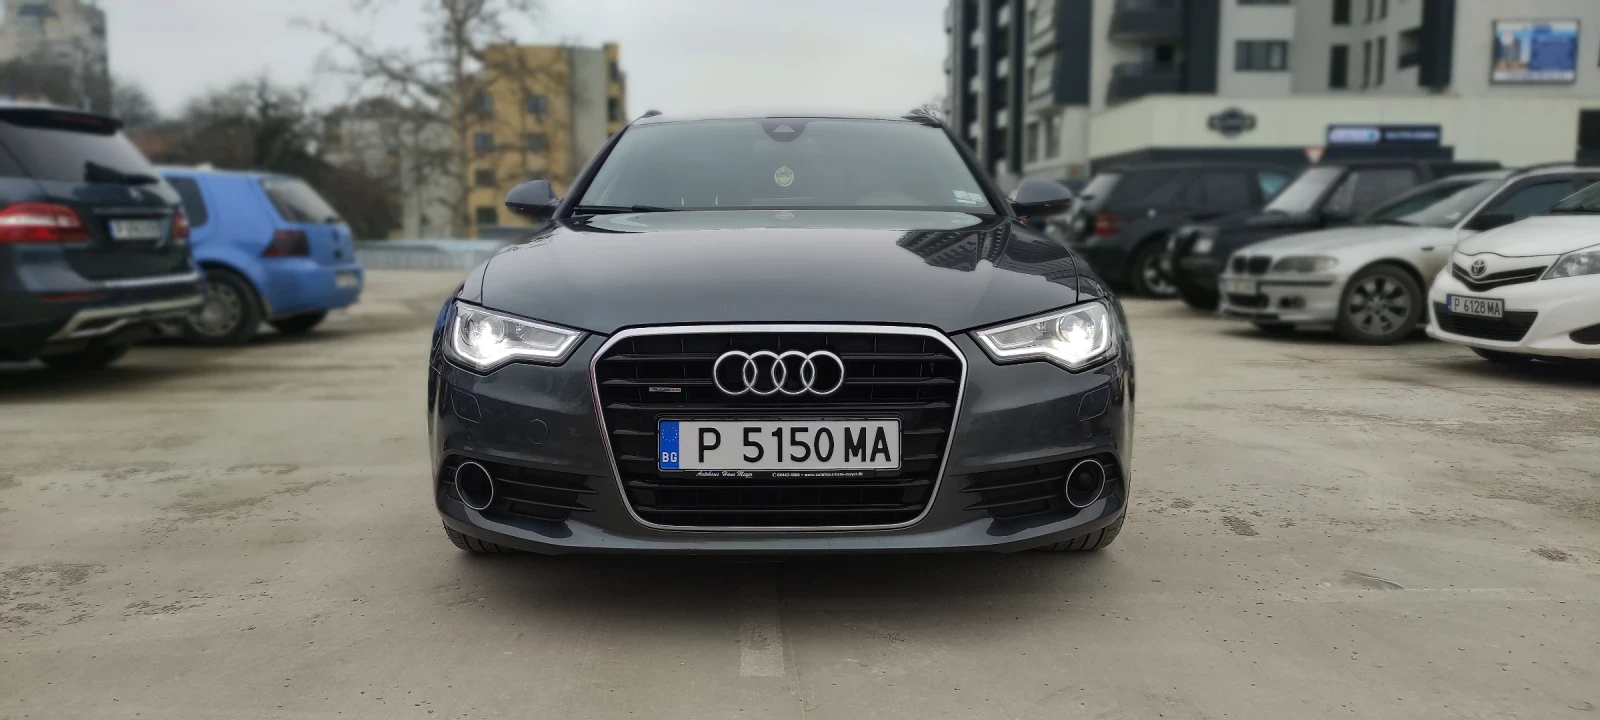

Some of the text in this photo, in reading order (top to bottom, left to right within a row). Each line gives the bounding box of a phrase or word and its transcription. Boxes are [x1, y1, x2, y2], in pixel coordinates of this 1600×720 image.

[1454, 298, 1500, 316] P 6128 MA
[698, 426, 892, 463] P 5150 MA
[662, 451, 678, 463] BG
